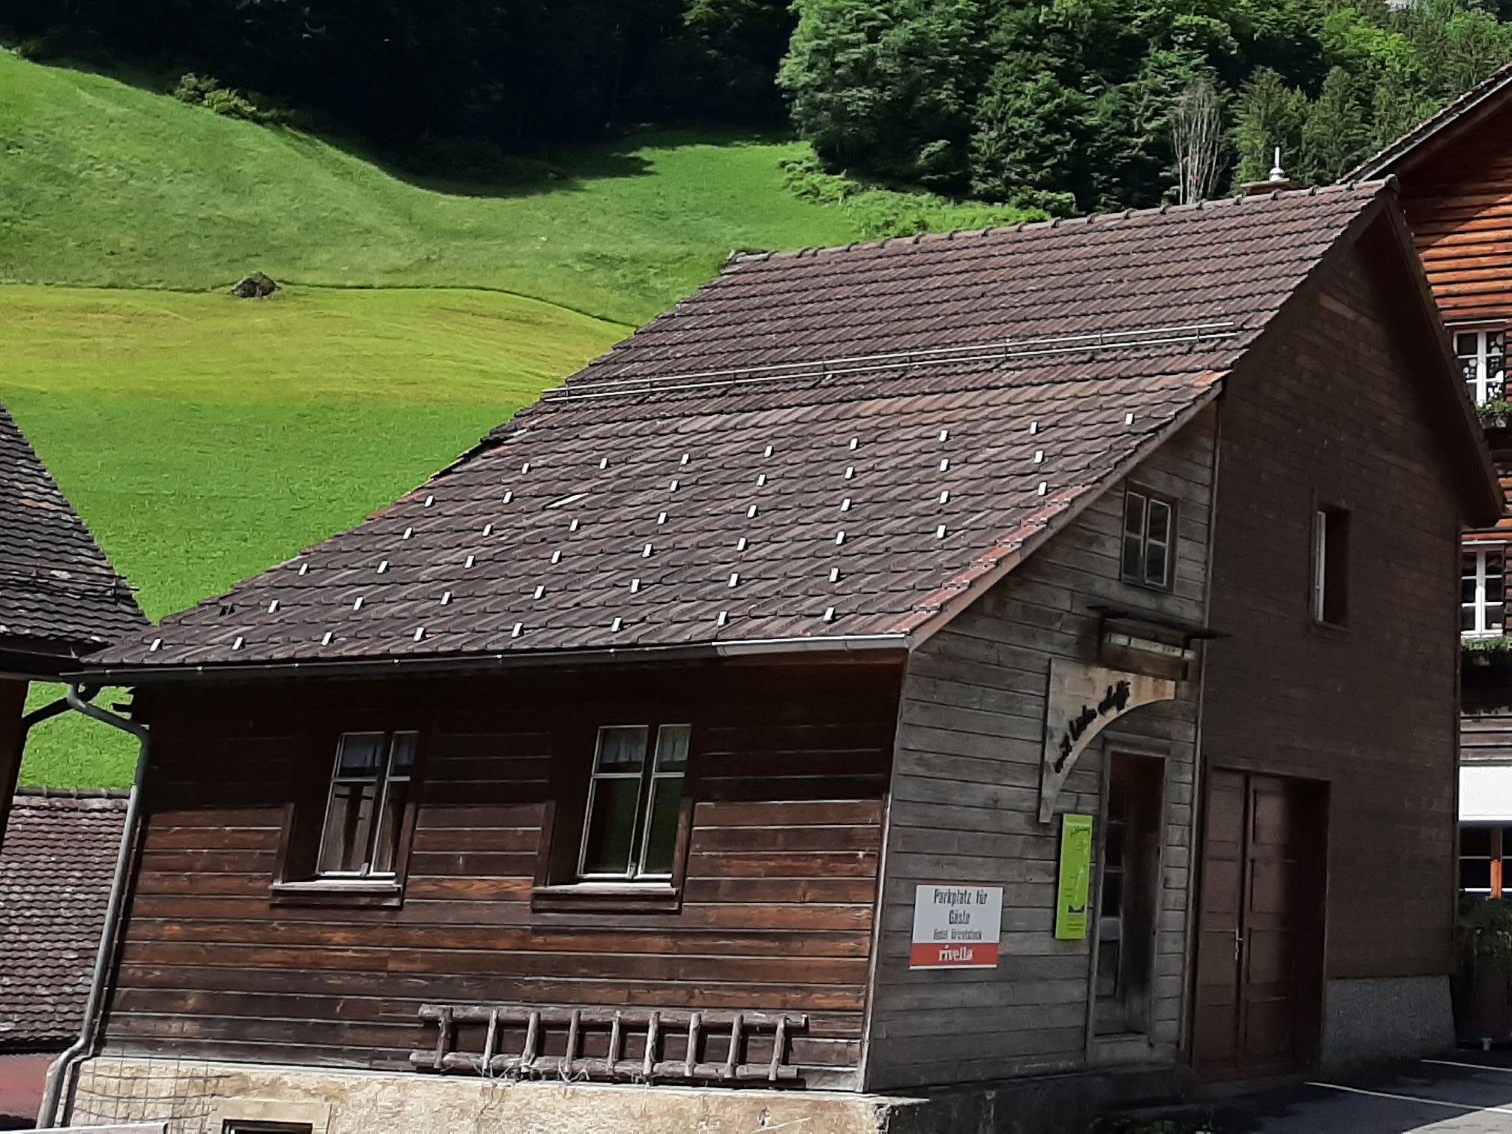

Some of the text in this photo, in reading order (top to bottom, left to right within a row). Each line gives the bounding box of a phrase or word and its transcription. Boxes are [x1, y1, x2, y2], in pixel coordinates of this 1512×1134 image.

[933, 888, 988, 907] Parkplatz für
[948, 909, 971, 925] Gäste
[938, 945, 973, 962] rivella
